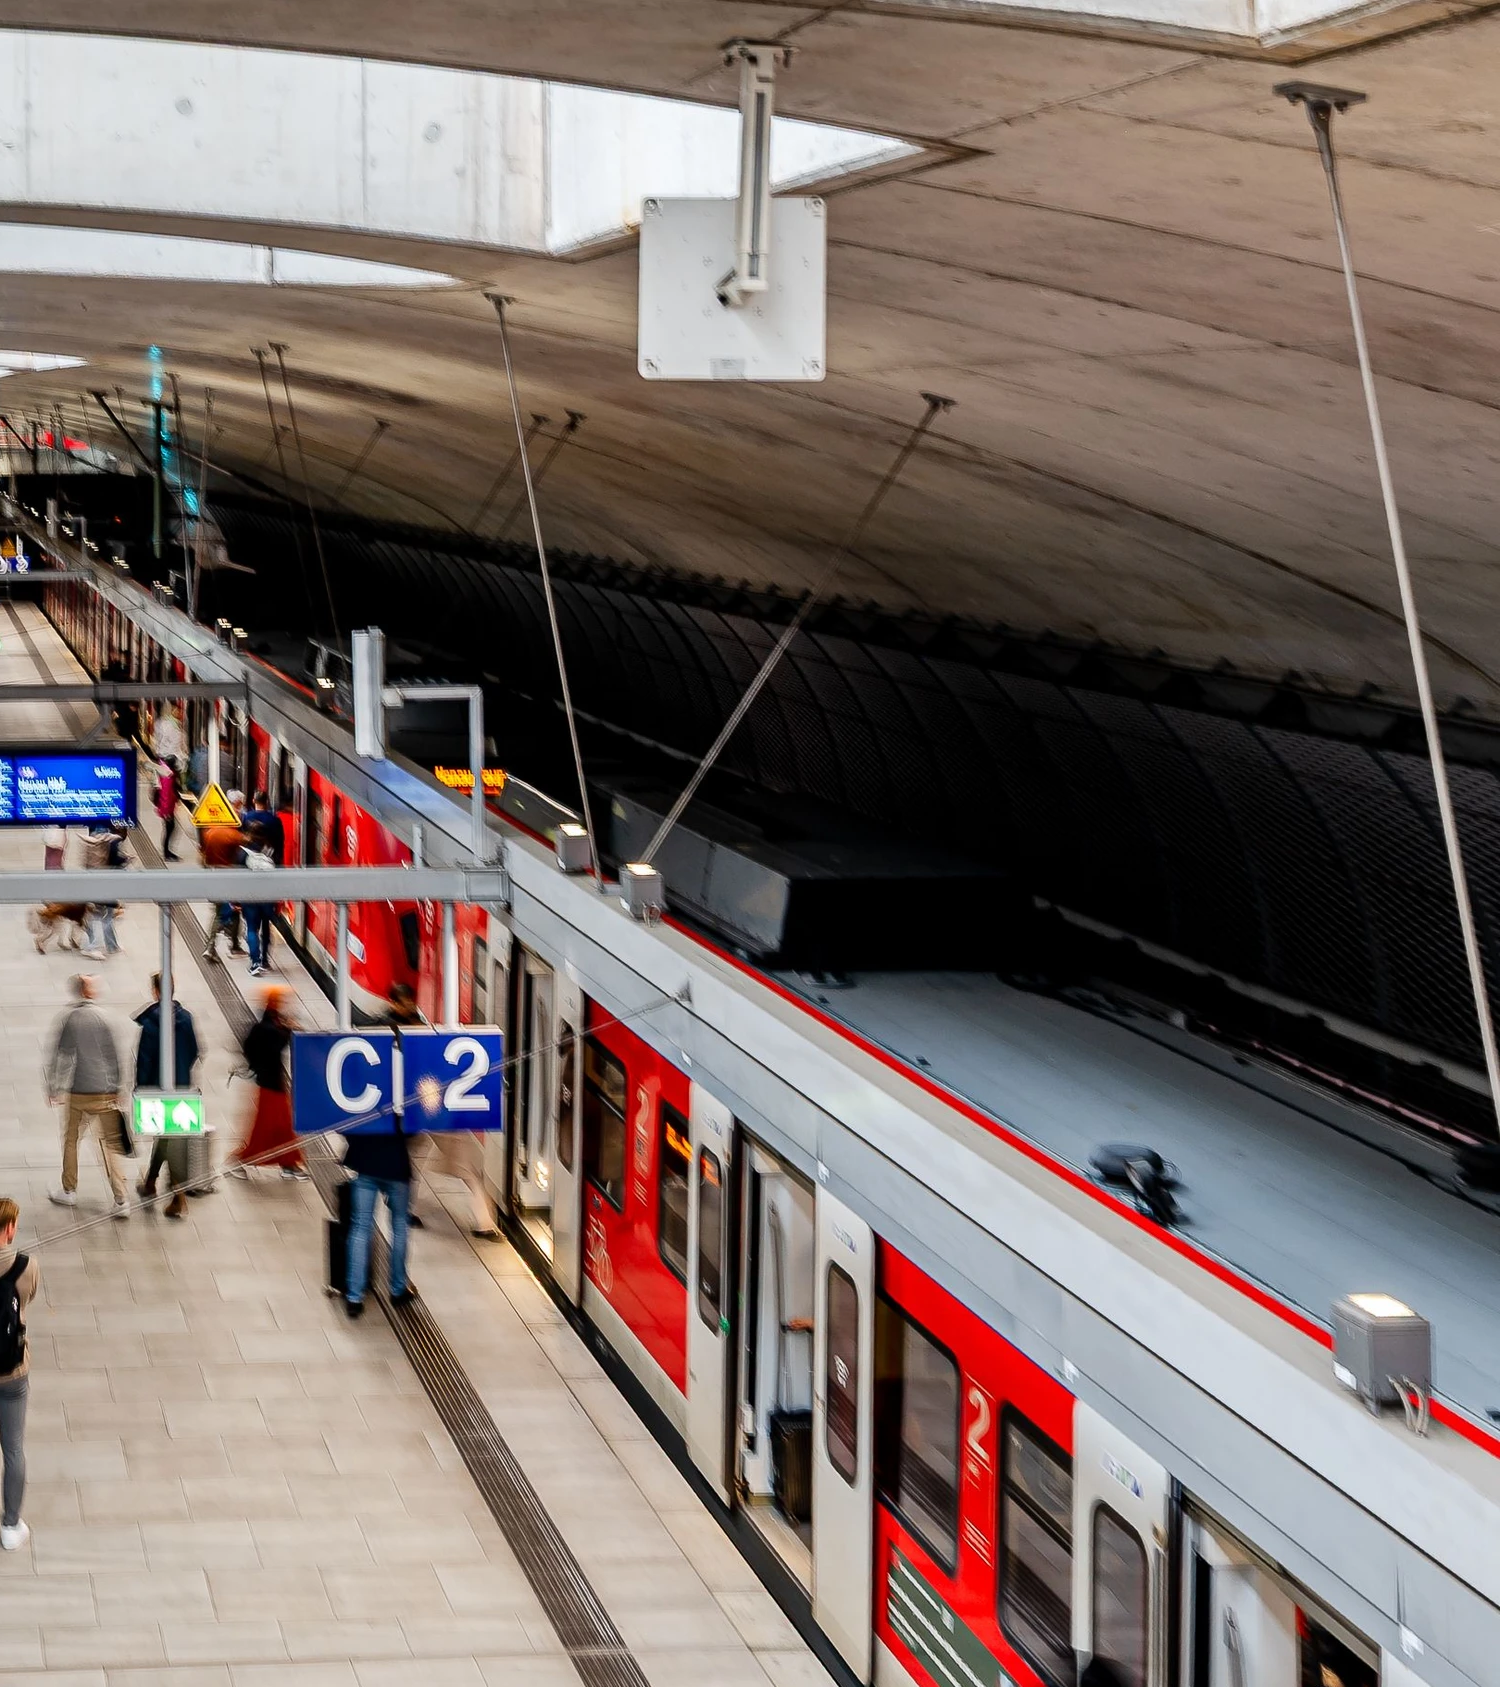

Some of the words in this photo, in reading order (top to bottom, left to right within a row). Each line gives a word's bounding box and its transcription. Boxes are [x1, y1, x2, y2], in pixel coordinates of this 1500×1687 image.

[326, 1037, 382, 1114] C
[443, 1037, 490, 1111] 2
[968, 1386, 991, 1464] 2
